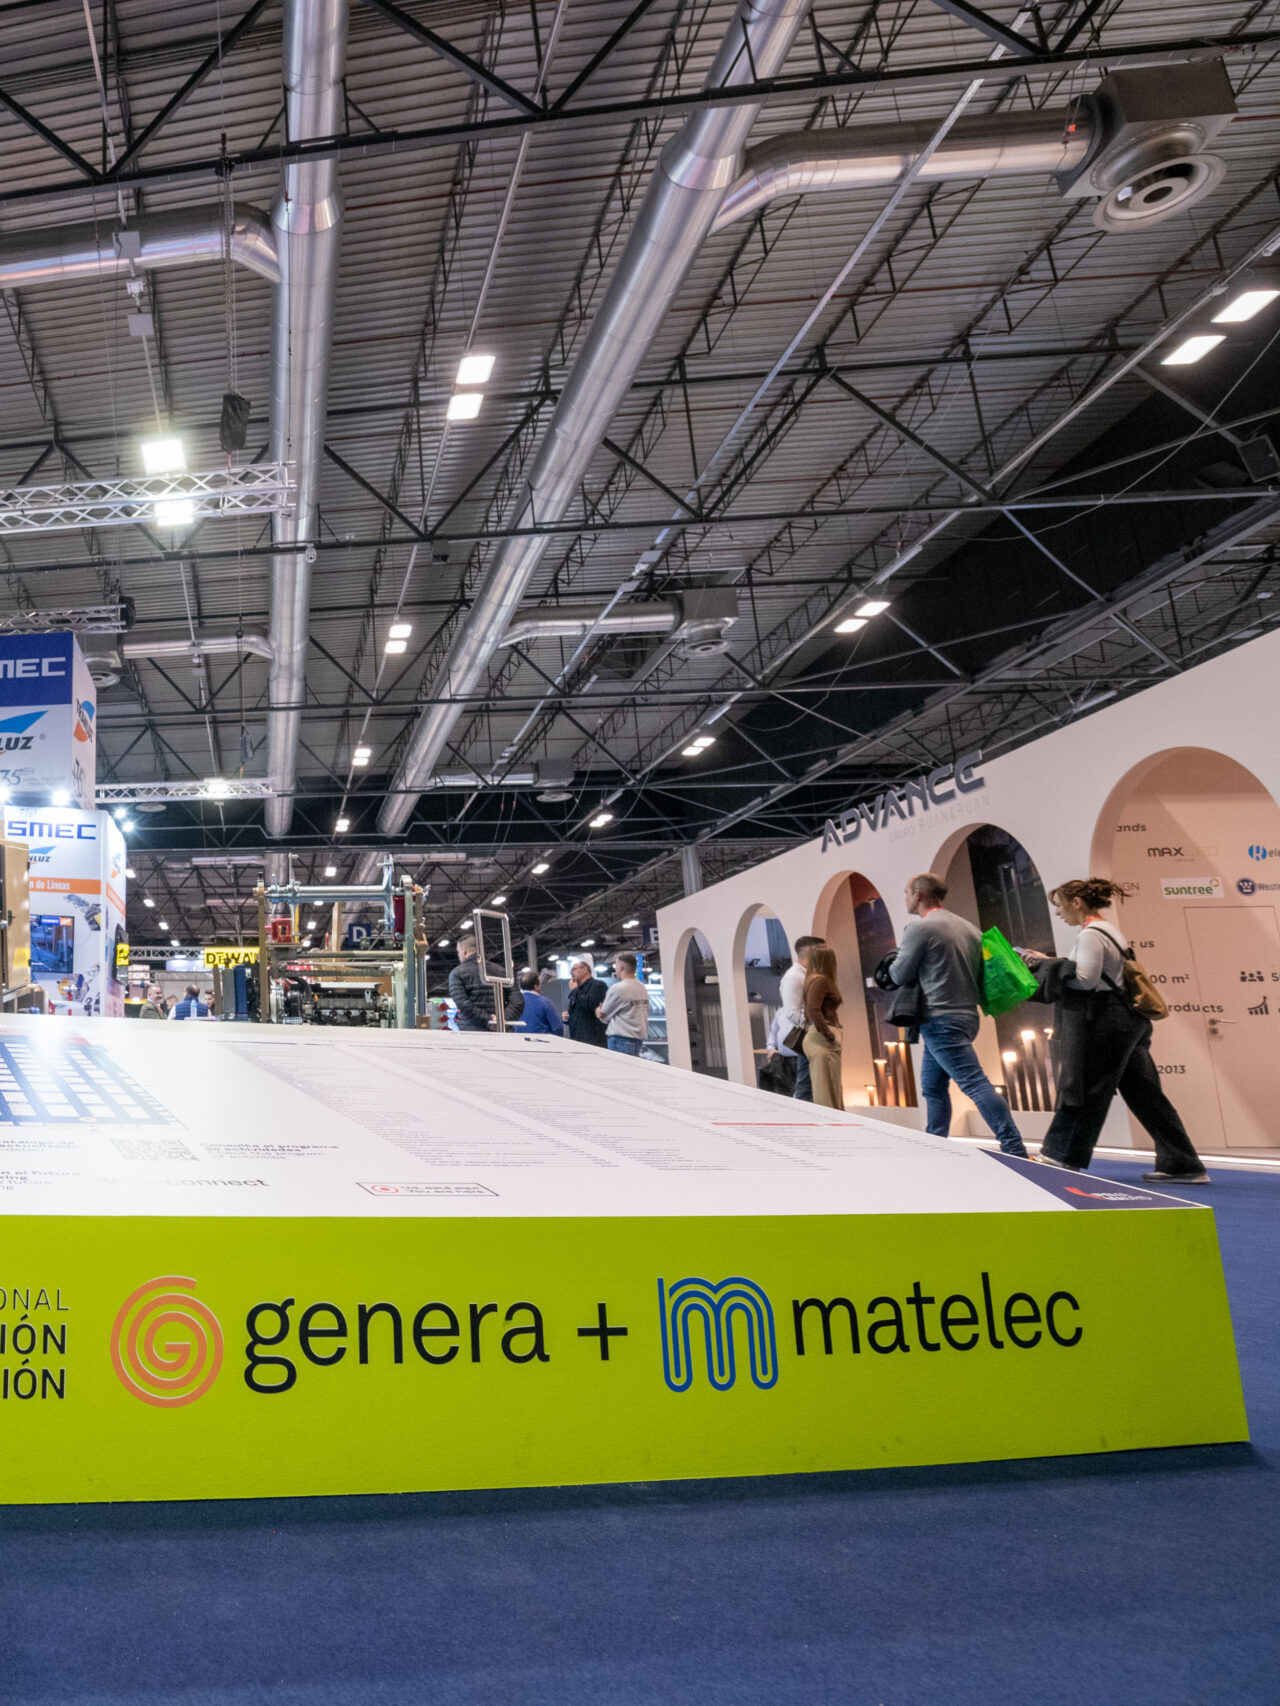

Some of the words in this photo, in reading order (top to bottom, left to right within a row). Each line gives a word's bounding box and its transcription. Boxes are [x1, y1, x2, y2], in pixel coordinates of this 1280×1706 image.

[821, 749, 987, 853] ADVANCE
[7, 820, 97, 840] SMEC
[1164, 884, 1214, 896] suntree
[1139, 940, 1155, 948] us
[1168, 1002, 1224, 1013] roducts
[1157, 1065, 1186, 1075] 2013
[243, 1296, 551, 1394] genera
[792, 1272, 1084, 1356] matelec
